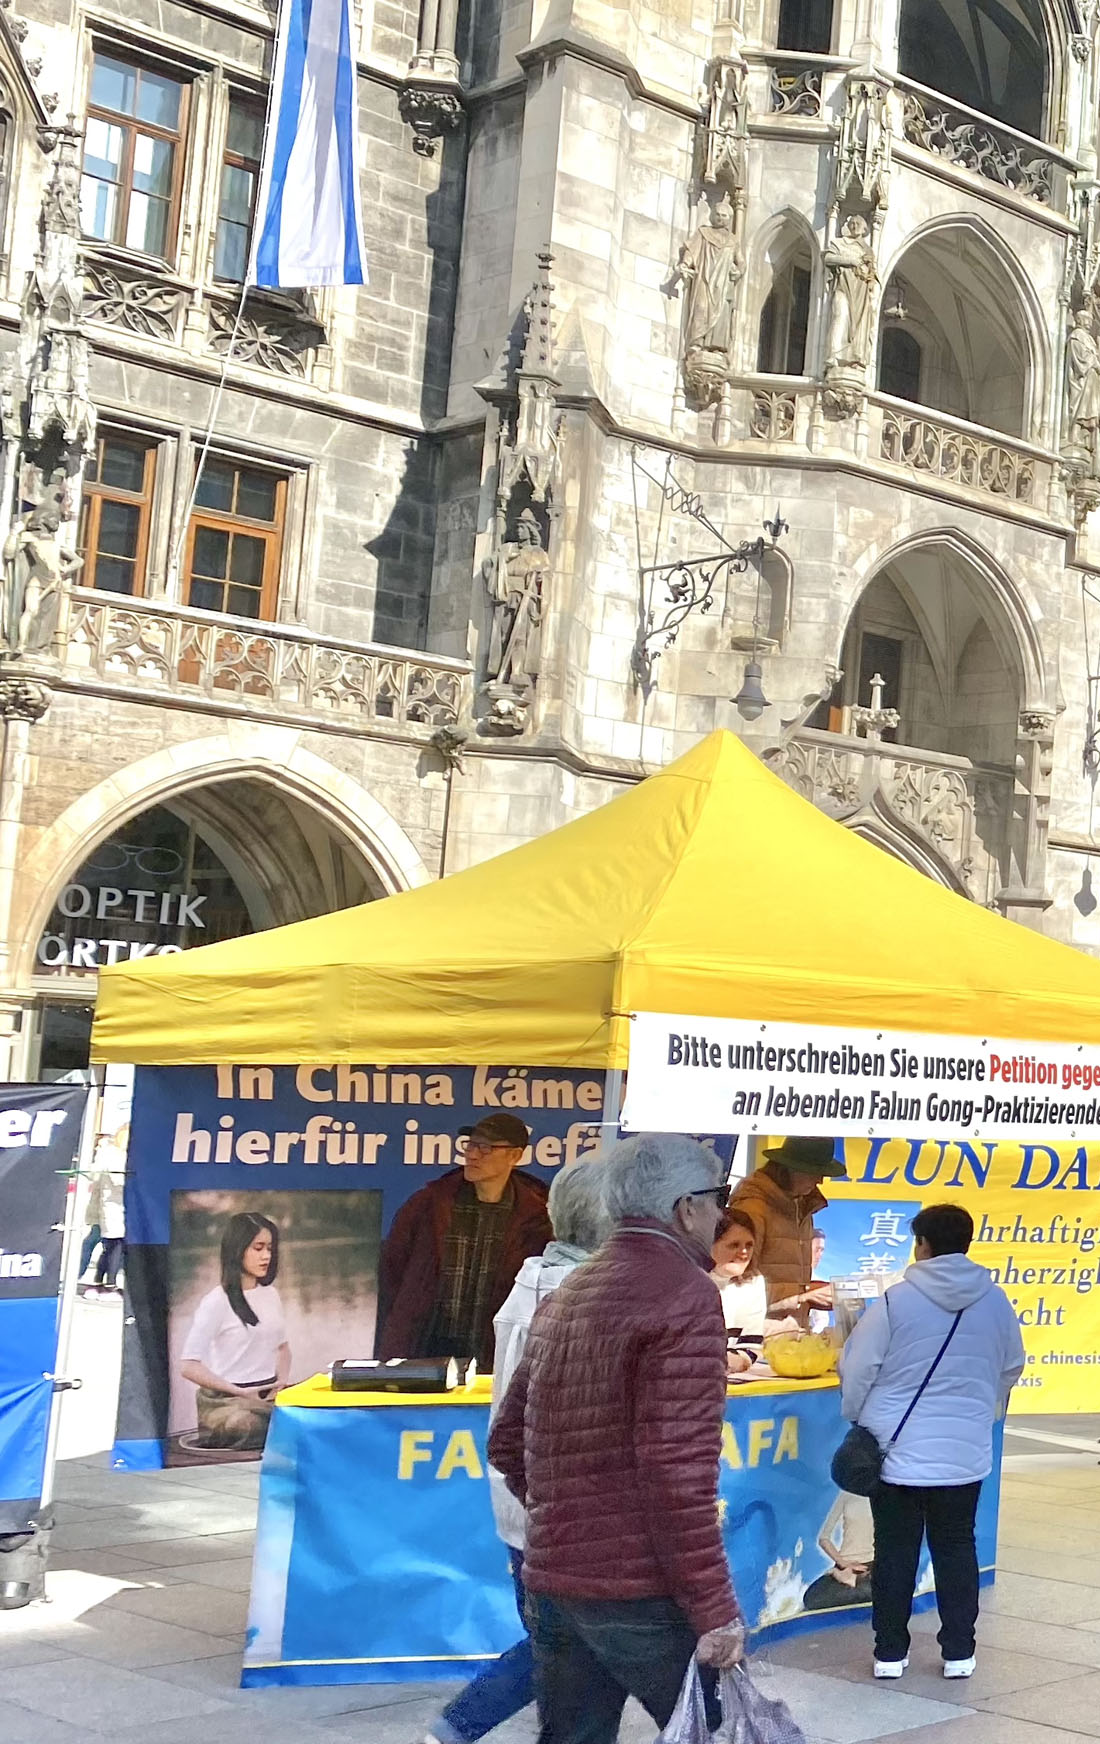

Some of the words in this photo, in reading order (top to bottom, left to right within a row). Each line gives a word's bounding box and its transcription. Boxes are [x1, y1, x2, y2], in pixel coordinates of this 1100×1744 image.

[57, 883, 208, 928] OPTIK
[667, 1033, 722, 1068] Bitte
[728, 1040, 885, 1077] unterschreiben
[889, 1048, 919, 1078] Sie
[923, 1056, 985, 1082] unsere
[989, 1054, 1058, 1085] Petition
[217, 1064, 274, 1100] In
[296, 1064, 455, 1106] China
[472, 1065, 627, 1111] käme
[732, 1090, 762, 1116] an
[764, 1085, 864, 1119] lebenden
[868, 1090, 921, 1121] Falun
[172, 1112, 388, 1165] hierfür
[397, 1430, 485, 1480] FA
[720, 1415, 799, 1471] AFA
